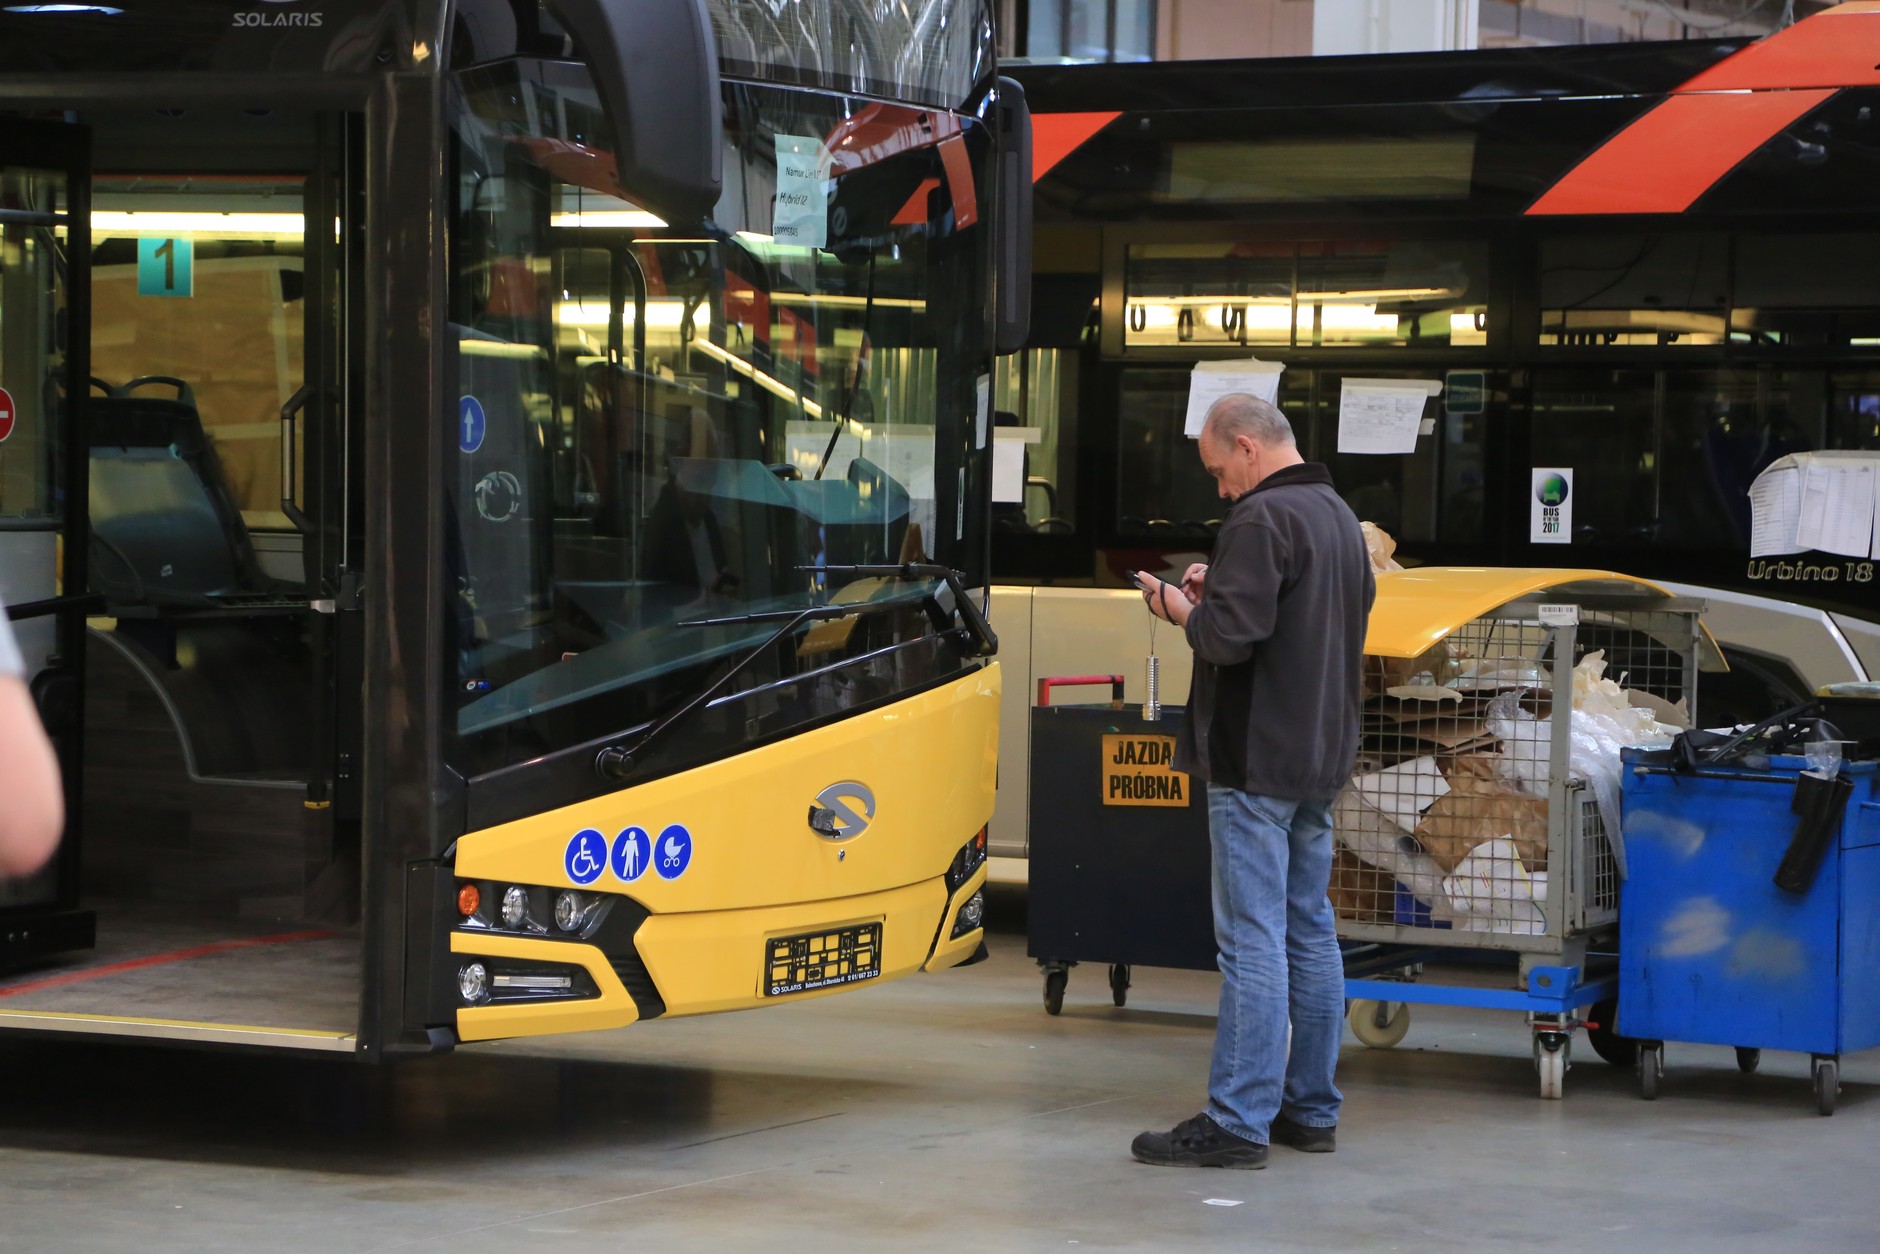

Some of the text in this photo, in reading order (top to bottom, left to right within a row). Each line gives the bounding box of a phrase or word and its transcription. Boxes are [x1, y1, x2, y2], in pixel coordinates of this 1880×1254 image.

[232, 12, 323, 27] SOLARIS
[780, 192, 801, 207] Hybrid
[155, 238, 174, 290] 1
[1543, 507, 1560, 517] BUS
[1543, 522, 1560, 533] 2017
[1747, 560, 1874, 582] Urbino 18
[1113, 741, 1172, 766] JAZDA
[1109, 771, 1183, 800] PRÓBNA
[780, 983, 802, 993] SOLARIS
